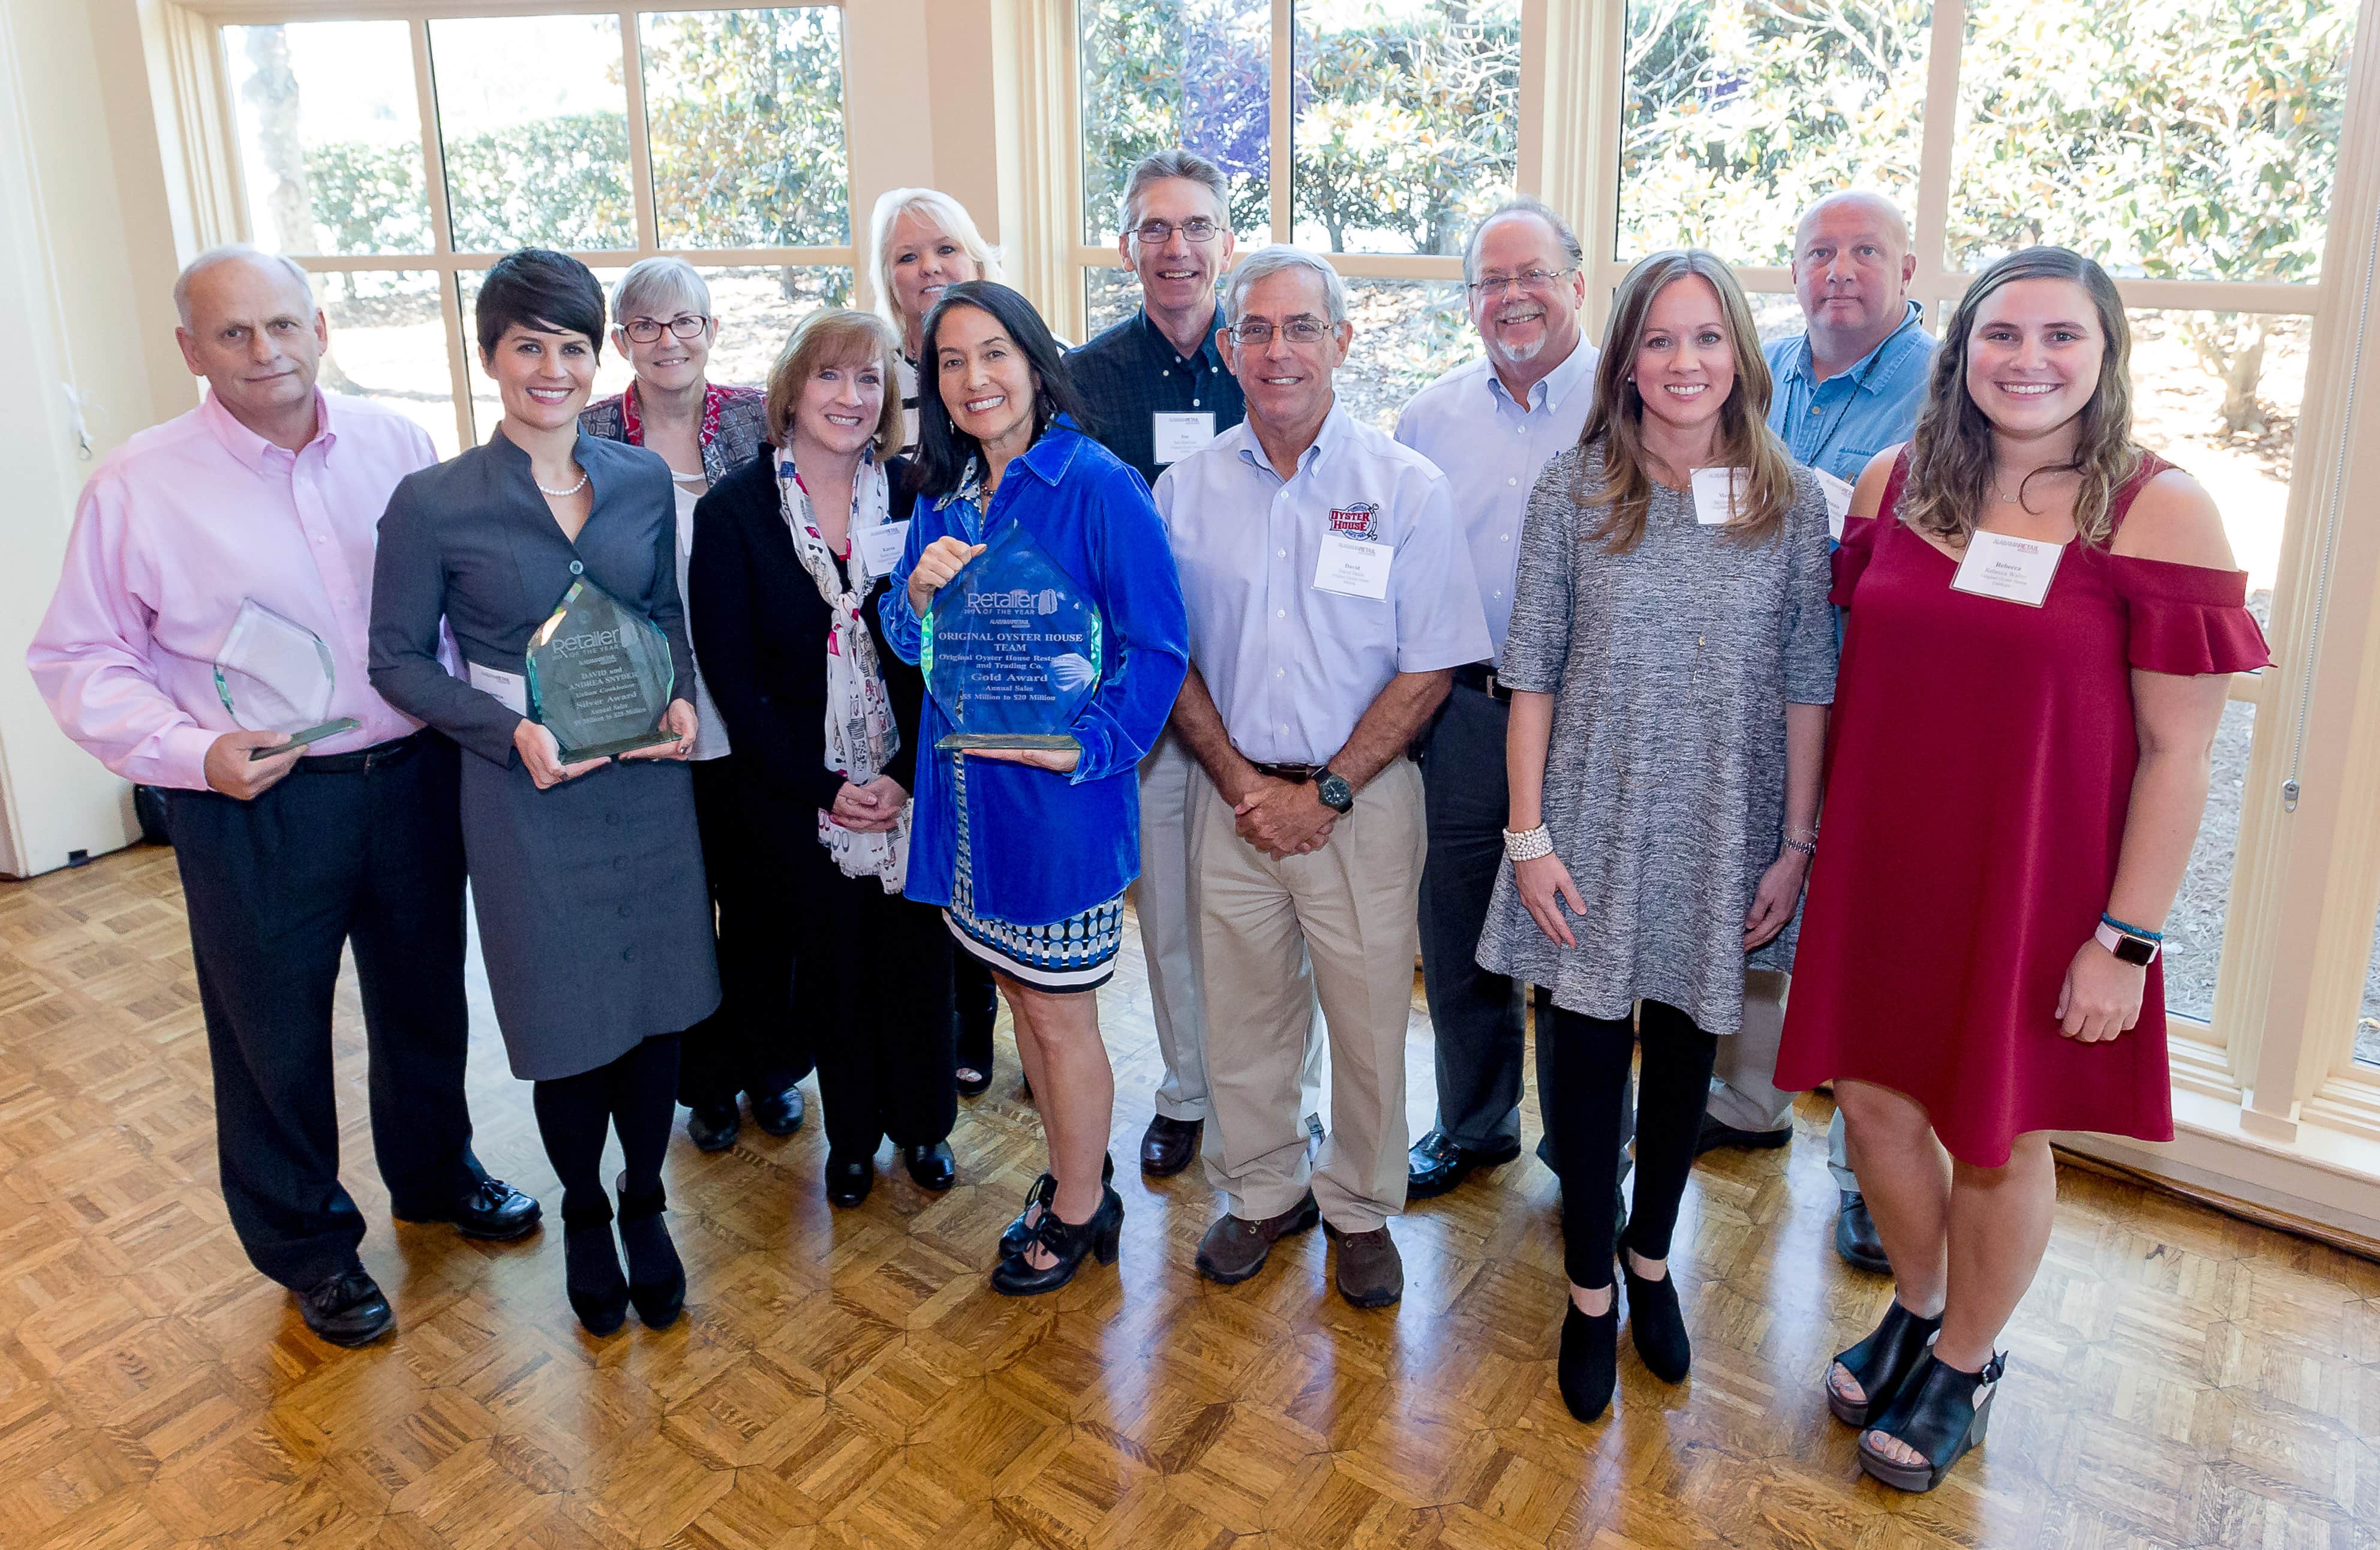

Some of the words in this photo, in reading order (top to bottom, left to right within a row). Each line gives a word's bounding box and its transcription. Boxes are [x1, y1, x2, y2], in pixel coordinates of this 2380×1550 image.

[1331, 510, 1371, 522] OYSTER
[1333, 519, 1367, 531] HOUSE
[1996, 562, 2021, 570] Rebecca
[967, 591, 1038, 614] Retailer
[937, 633, 994, 641] ORIGINAL
[997, 633, 1042, 641] OYSTER
[1045, 633, 1083, 642] HOUSE
[552, 629, 619, 659] Retailer
[993, 644, 1027, 652] TEAM
[581, 669, 606, 680] DAVID
[971, 673, 1002, 681] Gold
[1006, 674, 1048, 682] Award
[568, 679, 603, 690] ANDREA
[575, 699, 604, 709] Silver
[607, 691, 637, 702] Award
